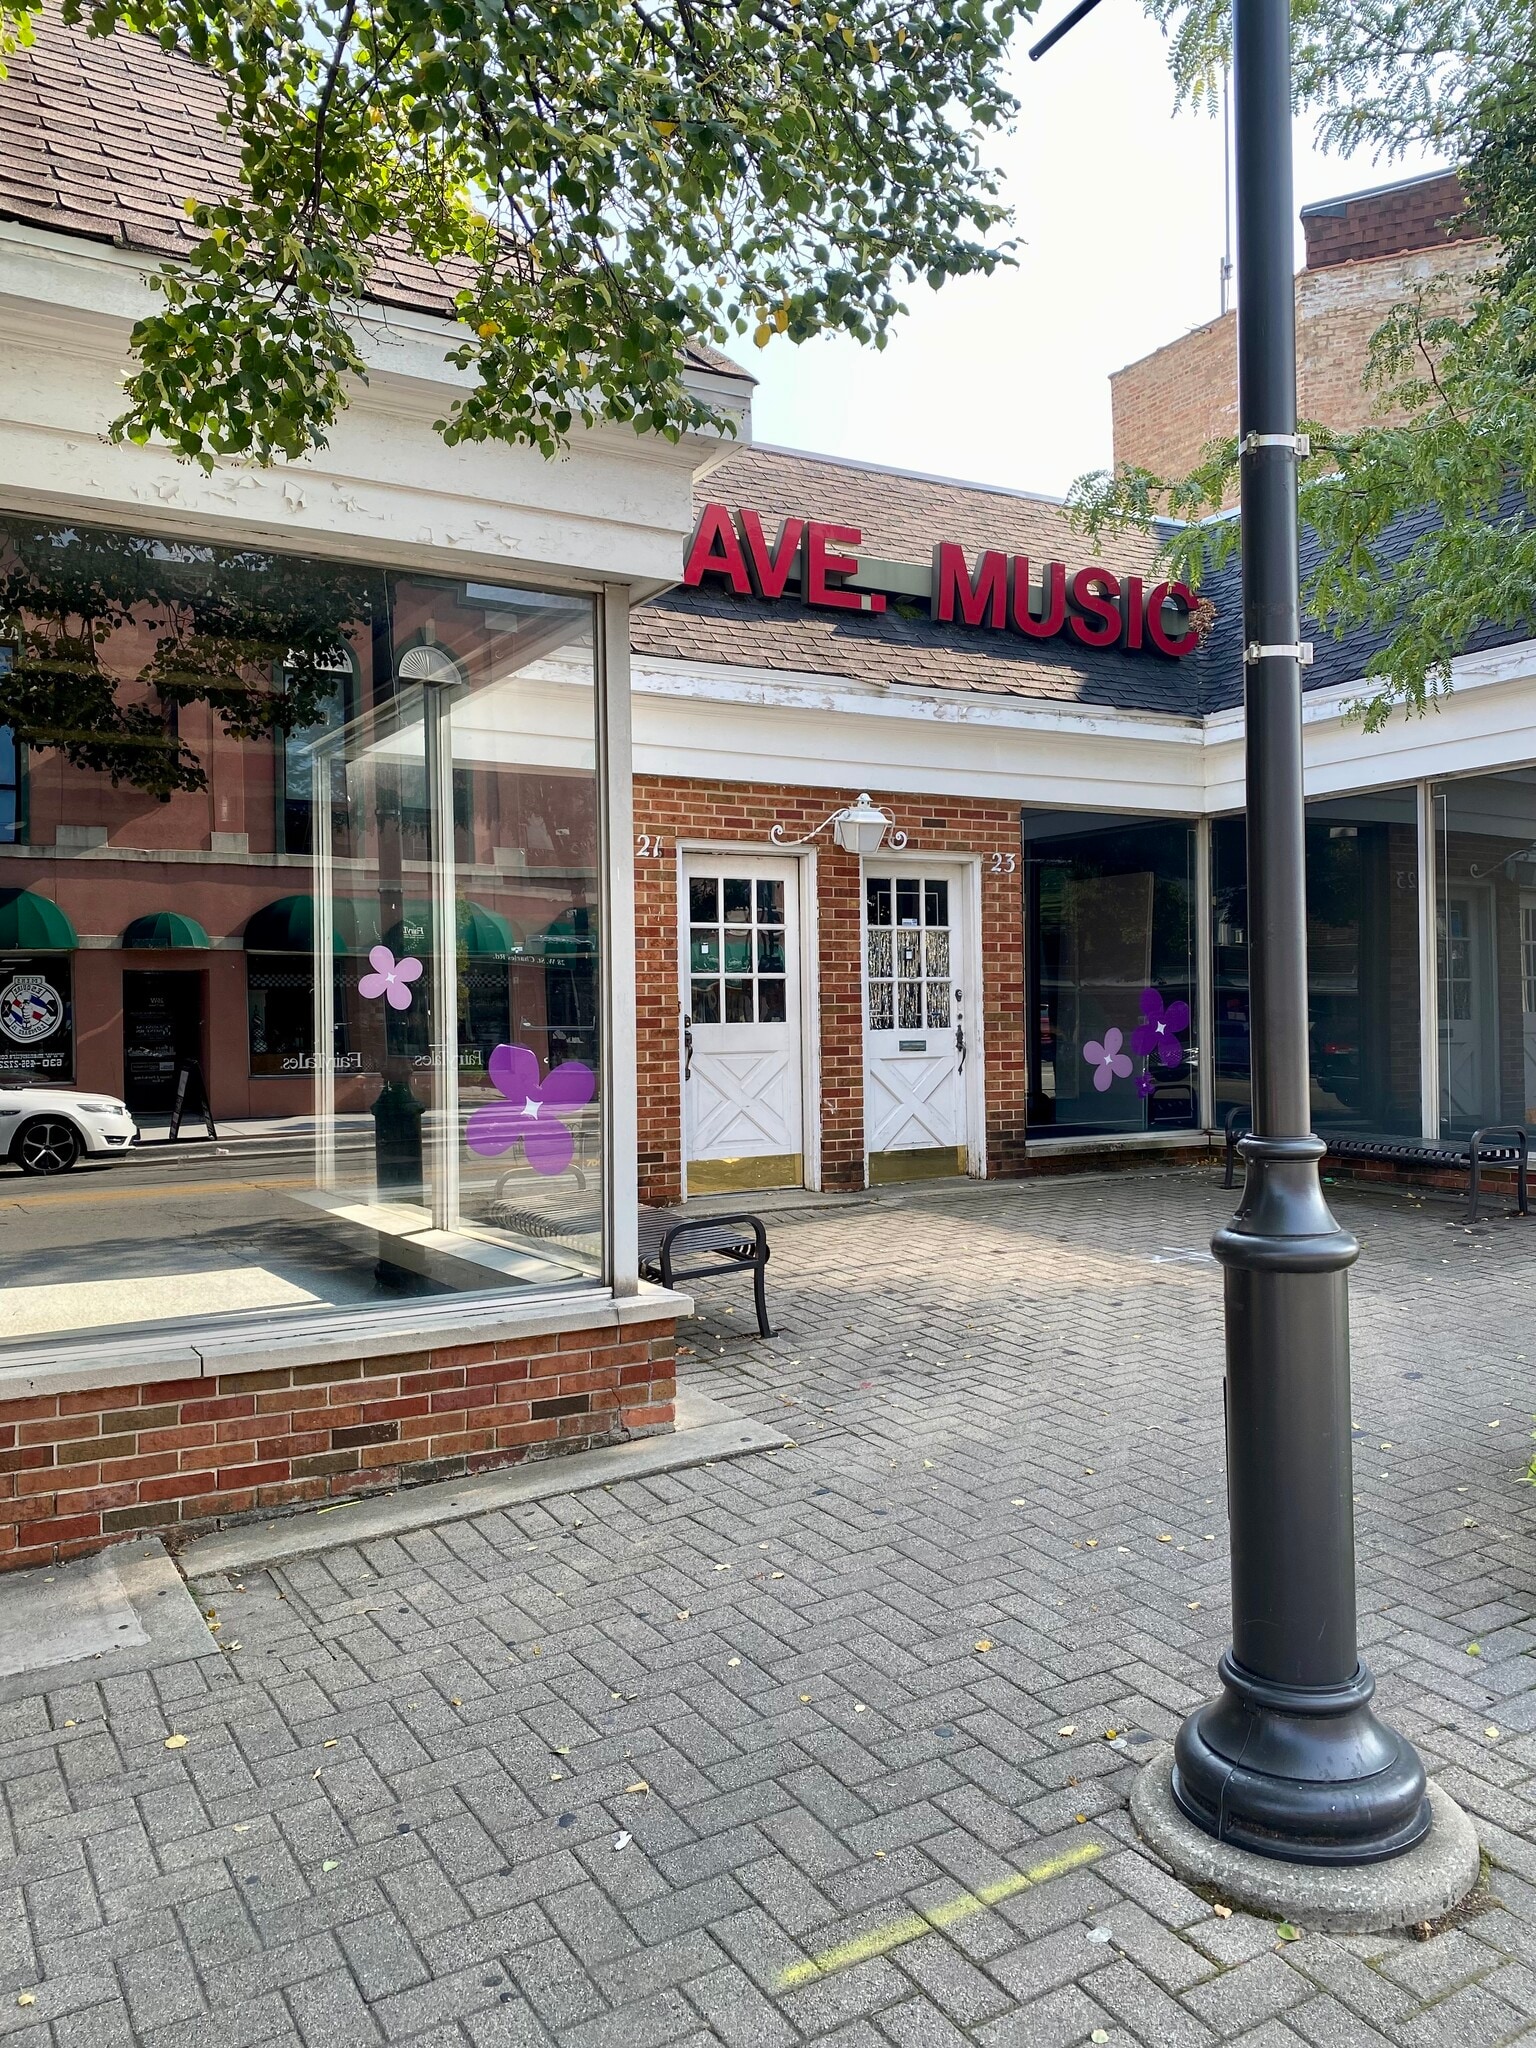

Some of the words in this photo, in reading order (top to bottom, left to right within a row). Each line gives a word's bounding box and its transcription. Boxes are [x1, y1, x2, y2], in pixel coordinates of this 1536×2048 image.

[684, 503, 887, 613] AVE.
[932, 541, 1201, 657] MUSIC
[991, 852, 1016, 873] 23
